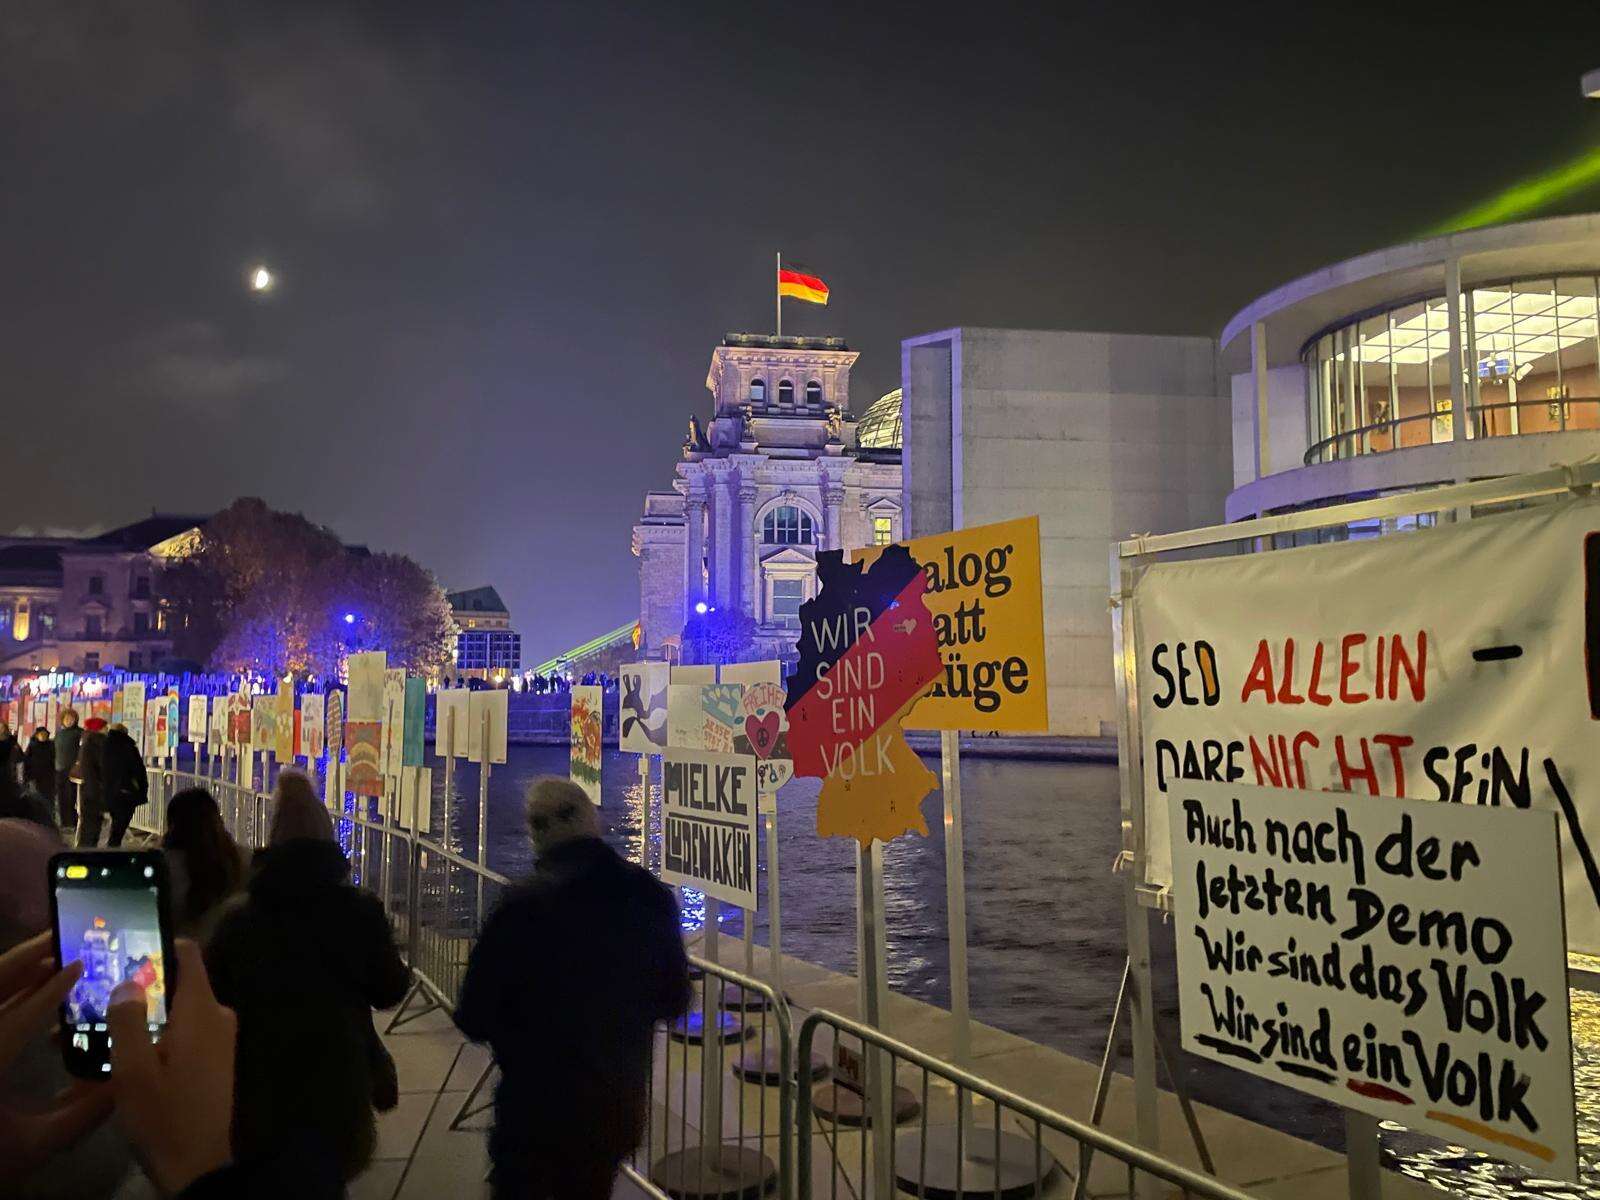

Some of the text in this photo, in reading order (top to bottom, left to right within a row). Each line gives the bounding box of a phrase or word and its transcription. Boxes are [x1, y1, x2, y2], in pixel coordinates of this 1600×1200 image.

[922, 544, 1013, 597] alog
[811, 606, 874, 654] WIR
[933, 598, 986, 646] att
[816, 652, 885, 700] SIND
[1152, 639, 1220, 708] SED
[1240, 630, 1426, 706] ALLEIN
[831, 694, 876, 734] EIN
[819, 733, 897, 781] VOLK
[1249, 730, 1414, 798] NICHT
[664, 761, 748, 816] MIELKE
[1183, 798, 1480, 884] Auch nach der
[1196, 860, 1513, 965] letzten Demo
[1195, 925, 1549, 1052] Wir sind das Volk
[1343, 1022, 1412, 1088] ein
[1403, 1029, 1540, 1133] Volk
